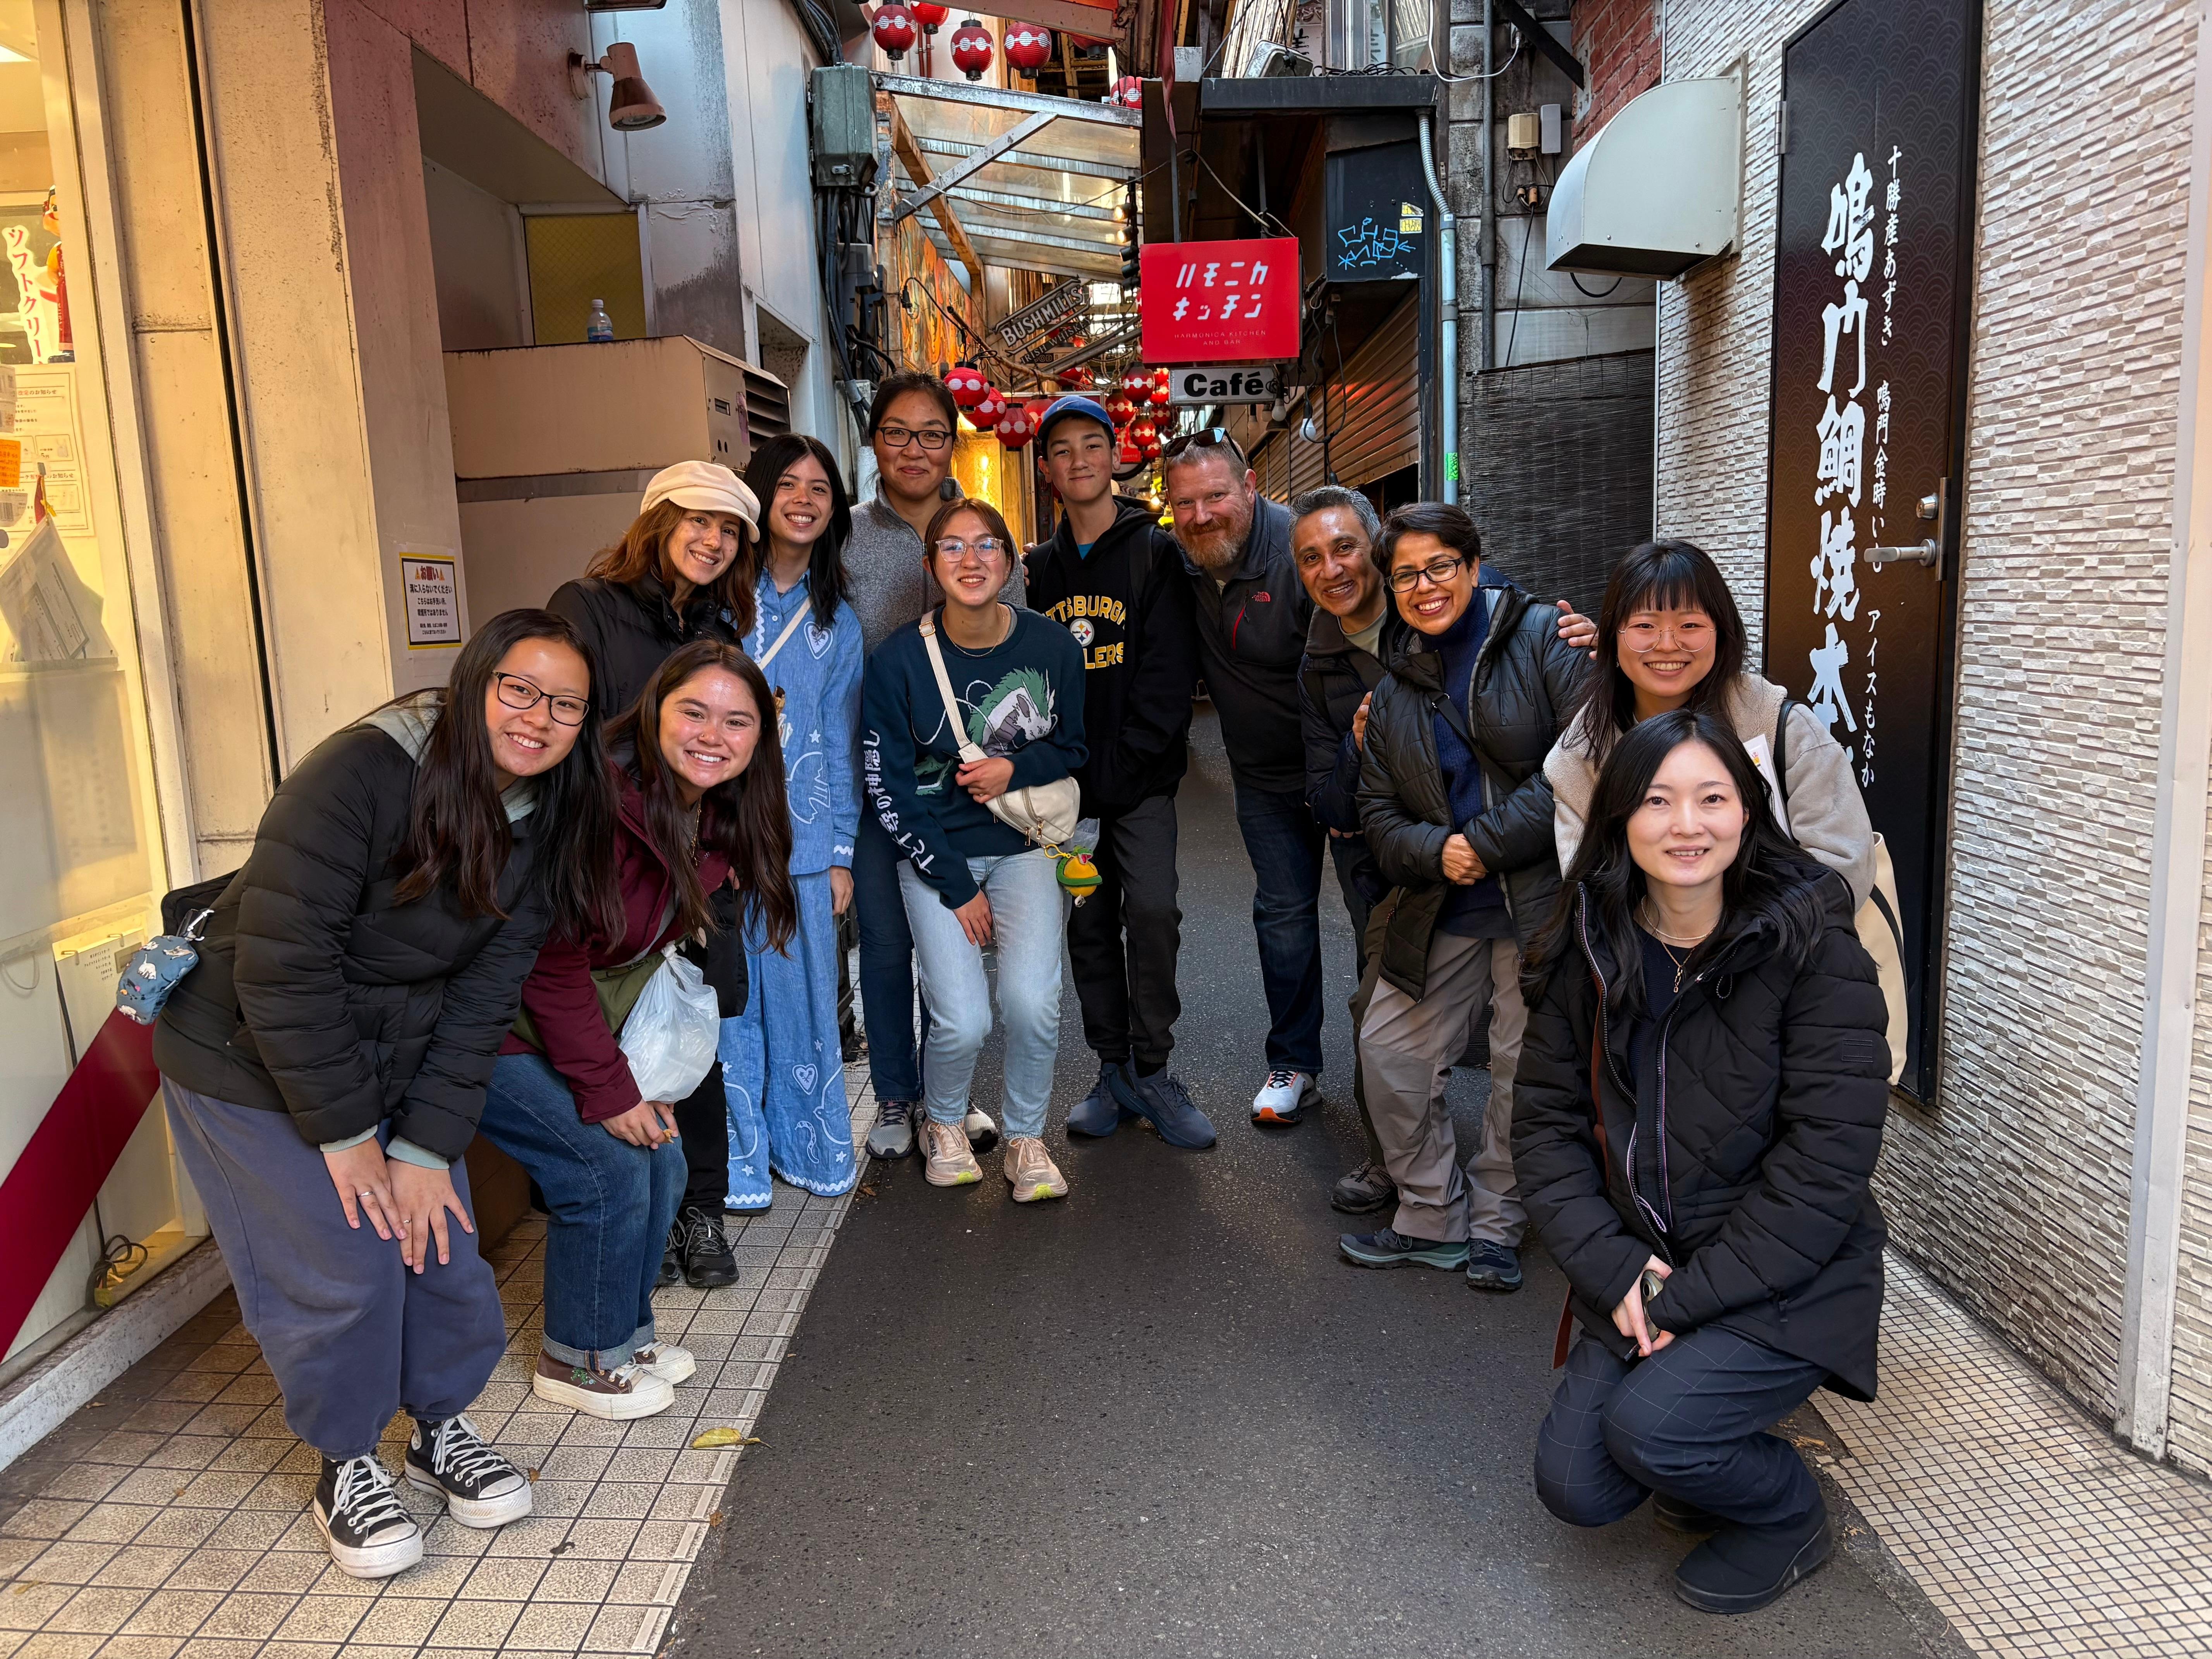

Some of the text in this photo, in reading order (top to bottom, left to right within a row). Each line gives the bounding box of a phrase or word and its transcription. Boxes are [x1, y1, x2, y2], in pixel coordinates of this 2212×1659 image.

[1881, 145, 1903, 346] 十勝産あずき
[1176, 261, 1269, 288] ハモニカ
[9, 229, 43, 364] ソフトクリー
[1173, 294, 1262, 321] キッチン
[1000, 287, 1083, 347] BUSHMILLS
[1020, 345, 1047, 364] IRISH
[1183, 371, 1264, 397] Café
[1807, 152, 1875, 763] 鳴門鯛焼本
[420, 565, 439, 581] お願い
[1042, 595, 1127, 630] TTSBURGH
[1082, 642, 1124, 670] LERS
[1861, 609, 1882, 788] アイスもなか
[863, 730, 934, 875] 千と千尋の神隠し
